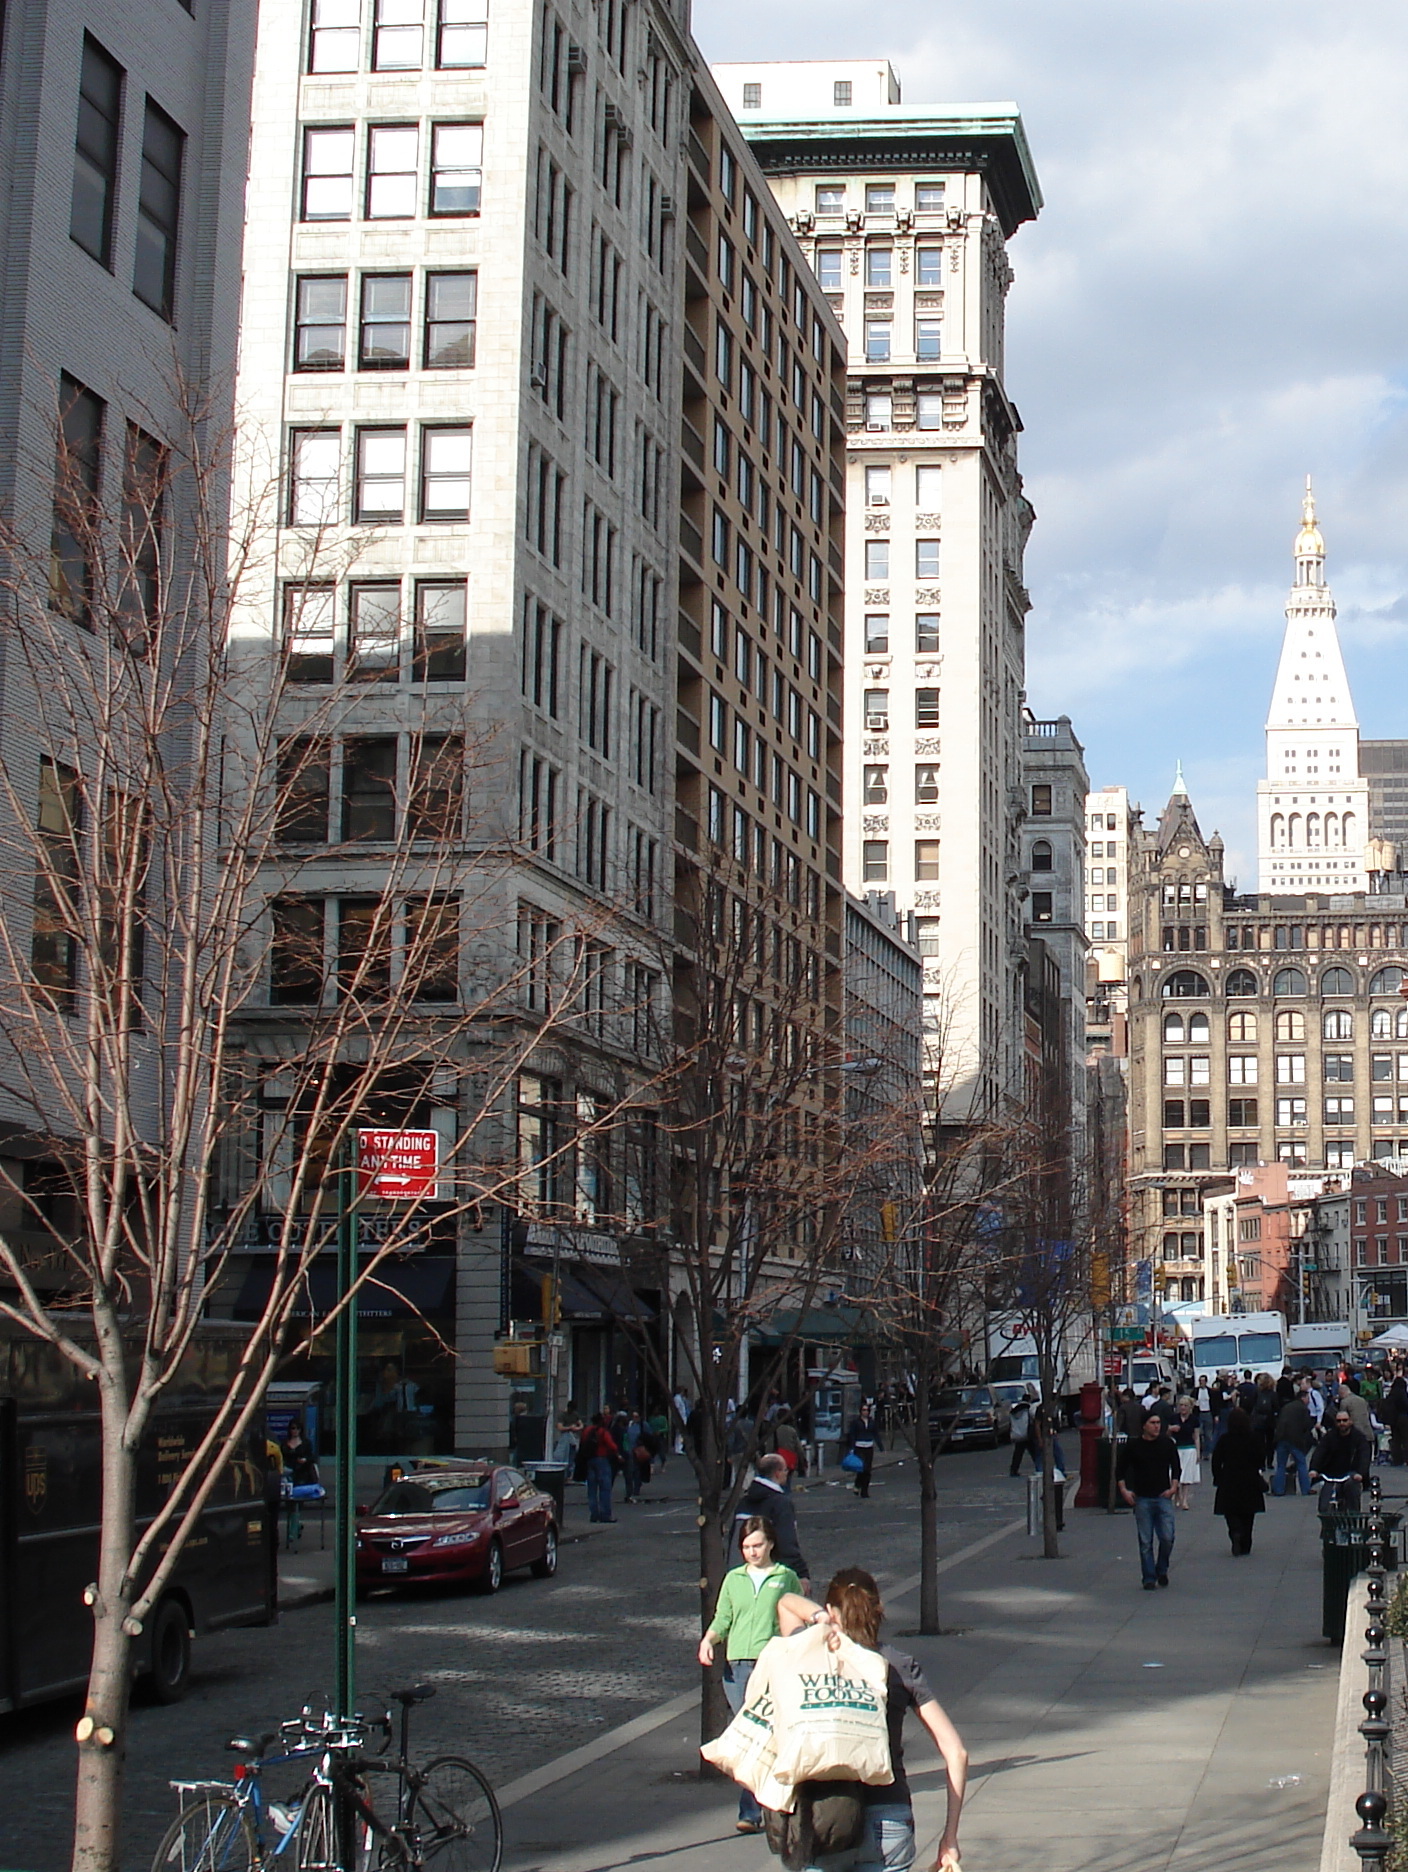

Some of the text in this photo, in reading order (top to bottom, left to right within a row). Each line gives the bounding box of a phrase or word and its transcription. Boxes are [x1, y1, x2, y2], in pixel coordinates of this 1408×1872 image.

[360, 1136, 431, 1151] O STANDING
[361, 1155, 421, 1169] ANYTIME
[26, 1473, 47, 1504] ups
[804, 1687, 875, 1702] FOODS
